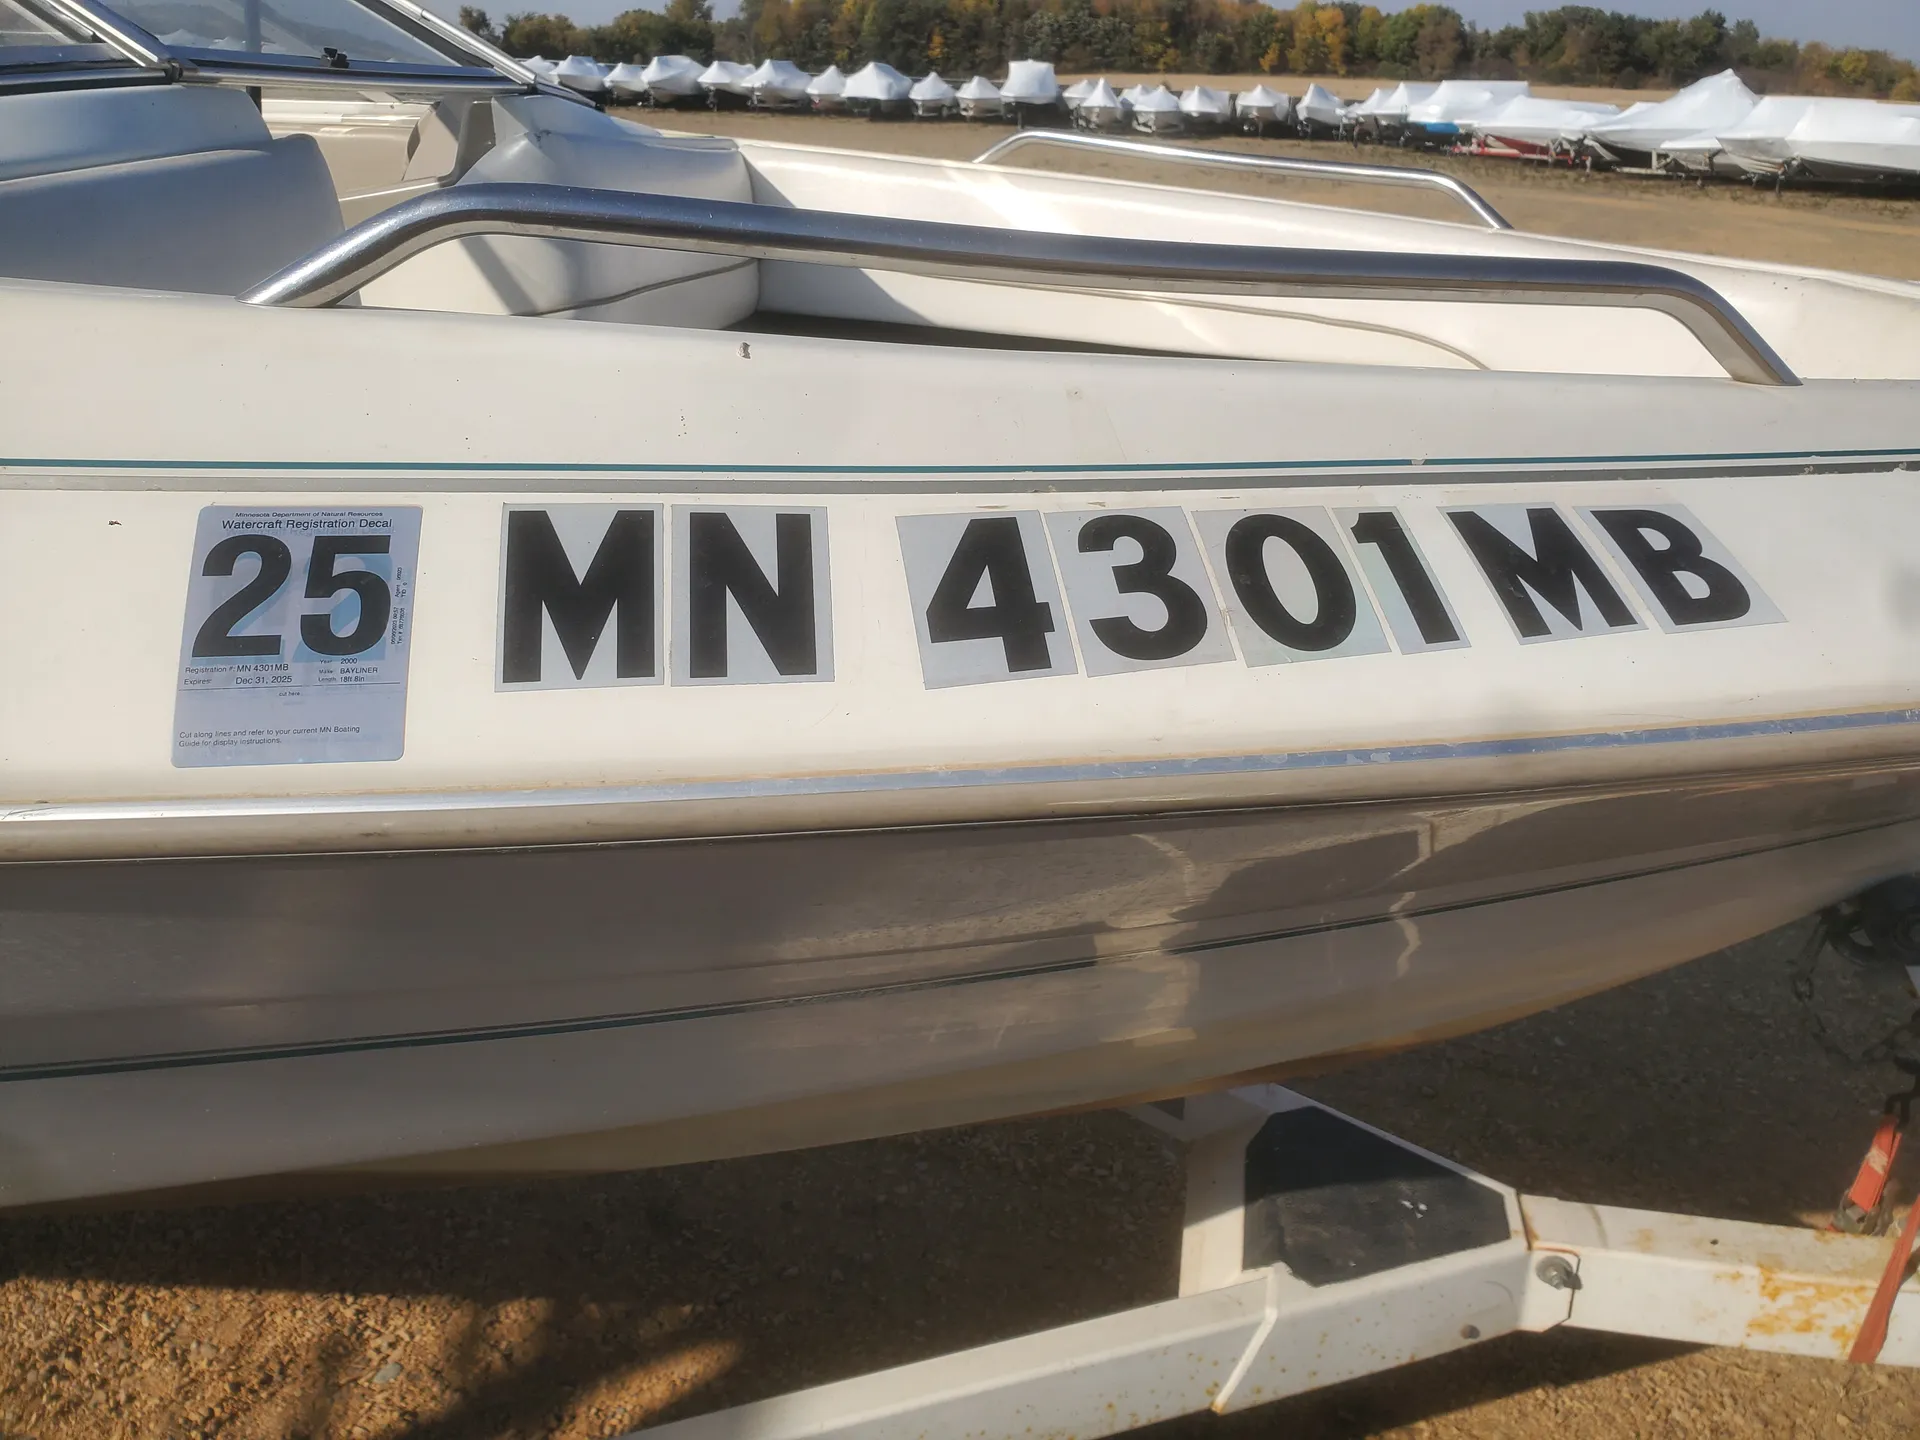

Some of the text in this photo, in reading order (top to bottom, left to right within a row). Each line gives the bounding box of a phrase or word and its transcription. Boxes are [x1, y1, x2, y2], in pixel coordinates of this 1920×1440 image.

[222, 518, 392, 530] Watercraft Registration Decal
[192, 534, 391, 657] 25
[502, 510, 817, 683] MN
[185, 666, 226, 674] Registration
[253, 664, 289, 672] 4301MB
[235, 677, 253, 685] Dec
[255, 676, 268, 685] 31,
[271, 675, 293, 683] 2025
[193, 731, 213, 739] along
[333, 725, 360, 733] Boating
[213, 738, 238, 746] display
